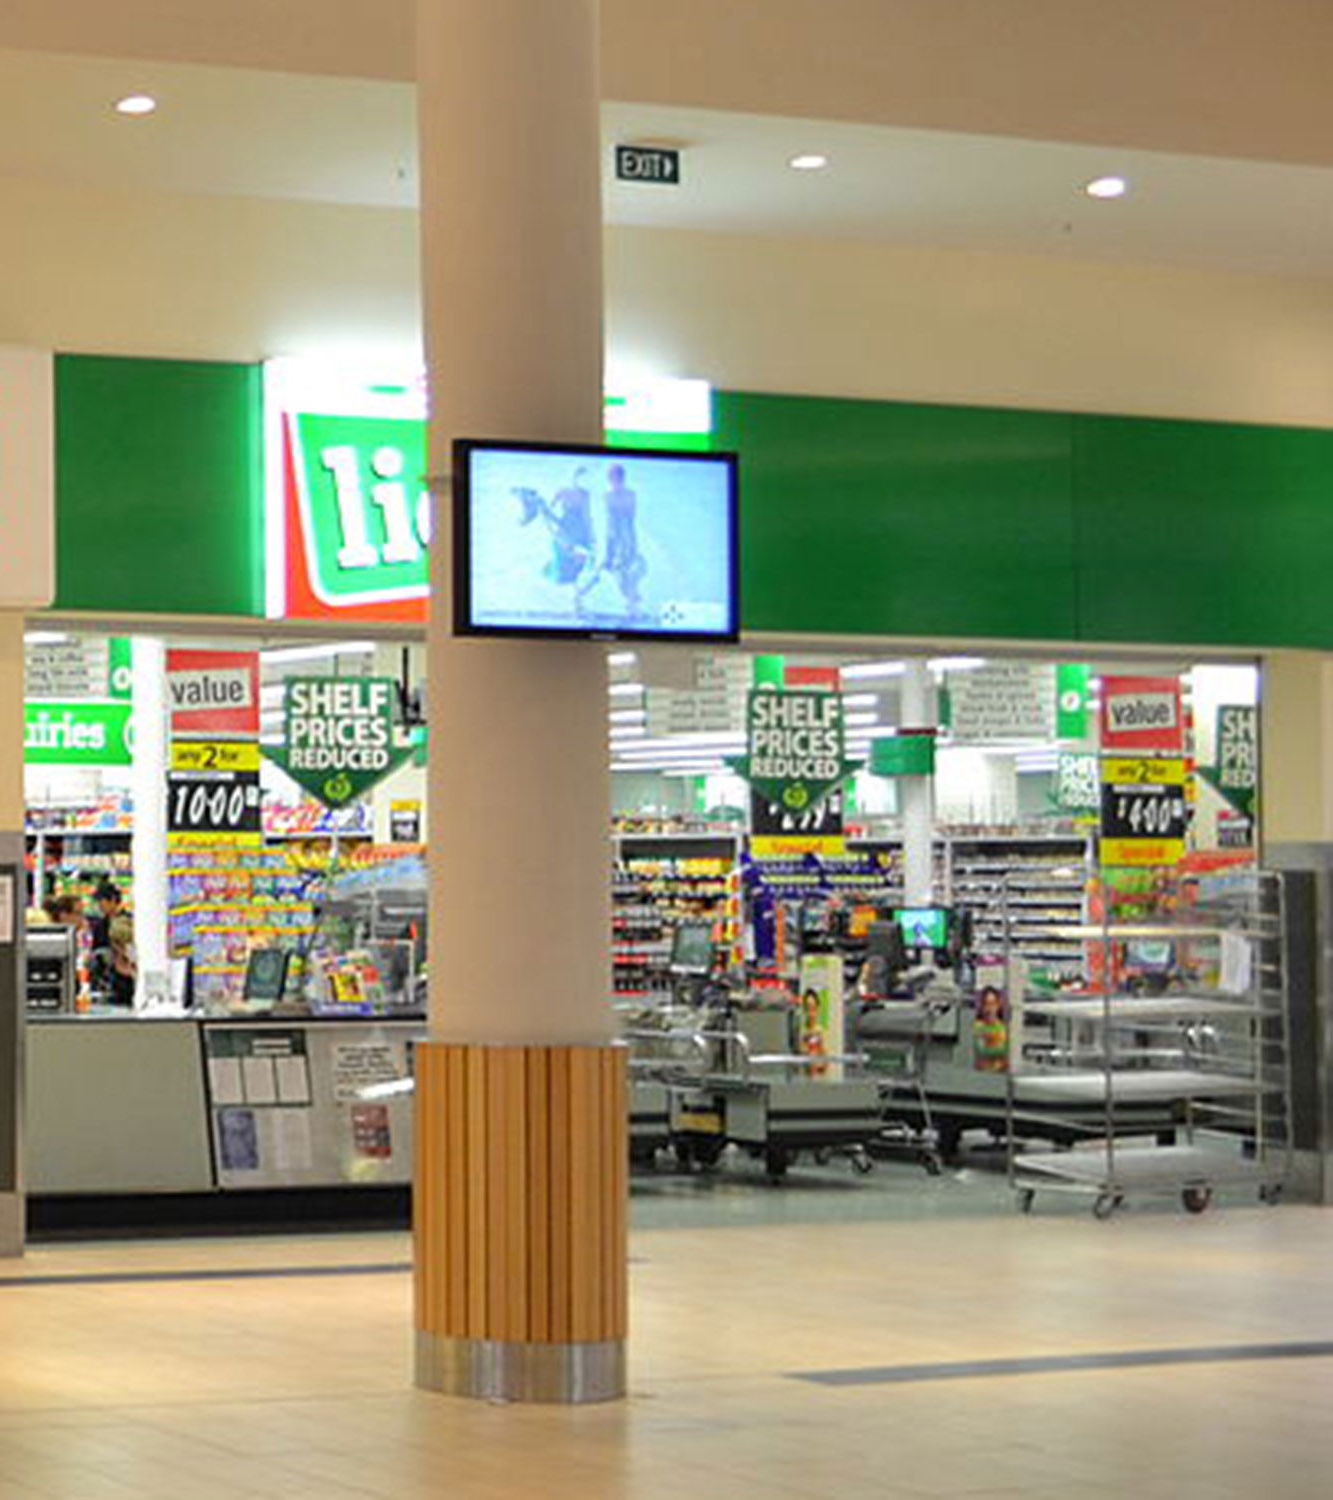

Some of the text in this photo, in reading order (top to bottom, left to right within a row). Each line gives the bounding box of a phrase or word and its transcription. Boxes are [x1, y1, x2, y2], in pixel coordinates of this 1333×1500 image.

[170, 676, 245, 704] value
[291, 682, 388, 715] SHELF
[752, 696, 838, 728] SHELF
[1111, 701, 1171, 725] value
[290, 717, 388, 746] PRICES
[751, 729, 839, 758] PRICES
[203, 745, 218, 769] 2
[288, 748, 389, 771] REDUCED
[750, 758, 840, 779] REDUCED
[1136, 761, 1150, 783] 2
